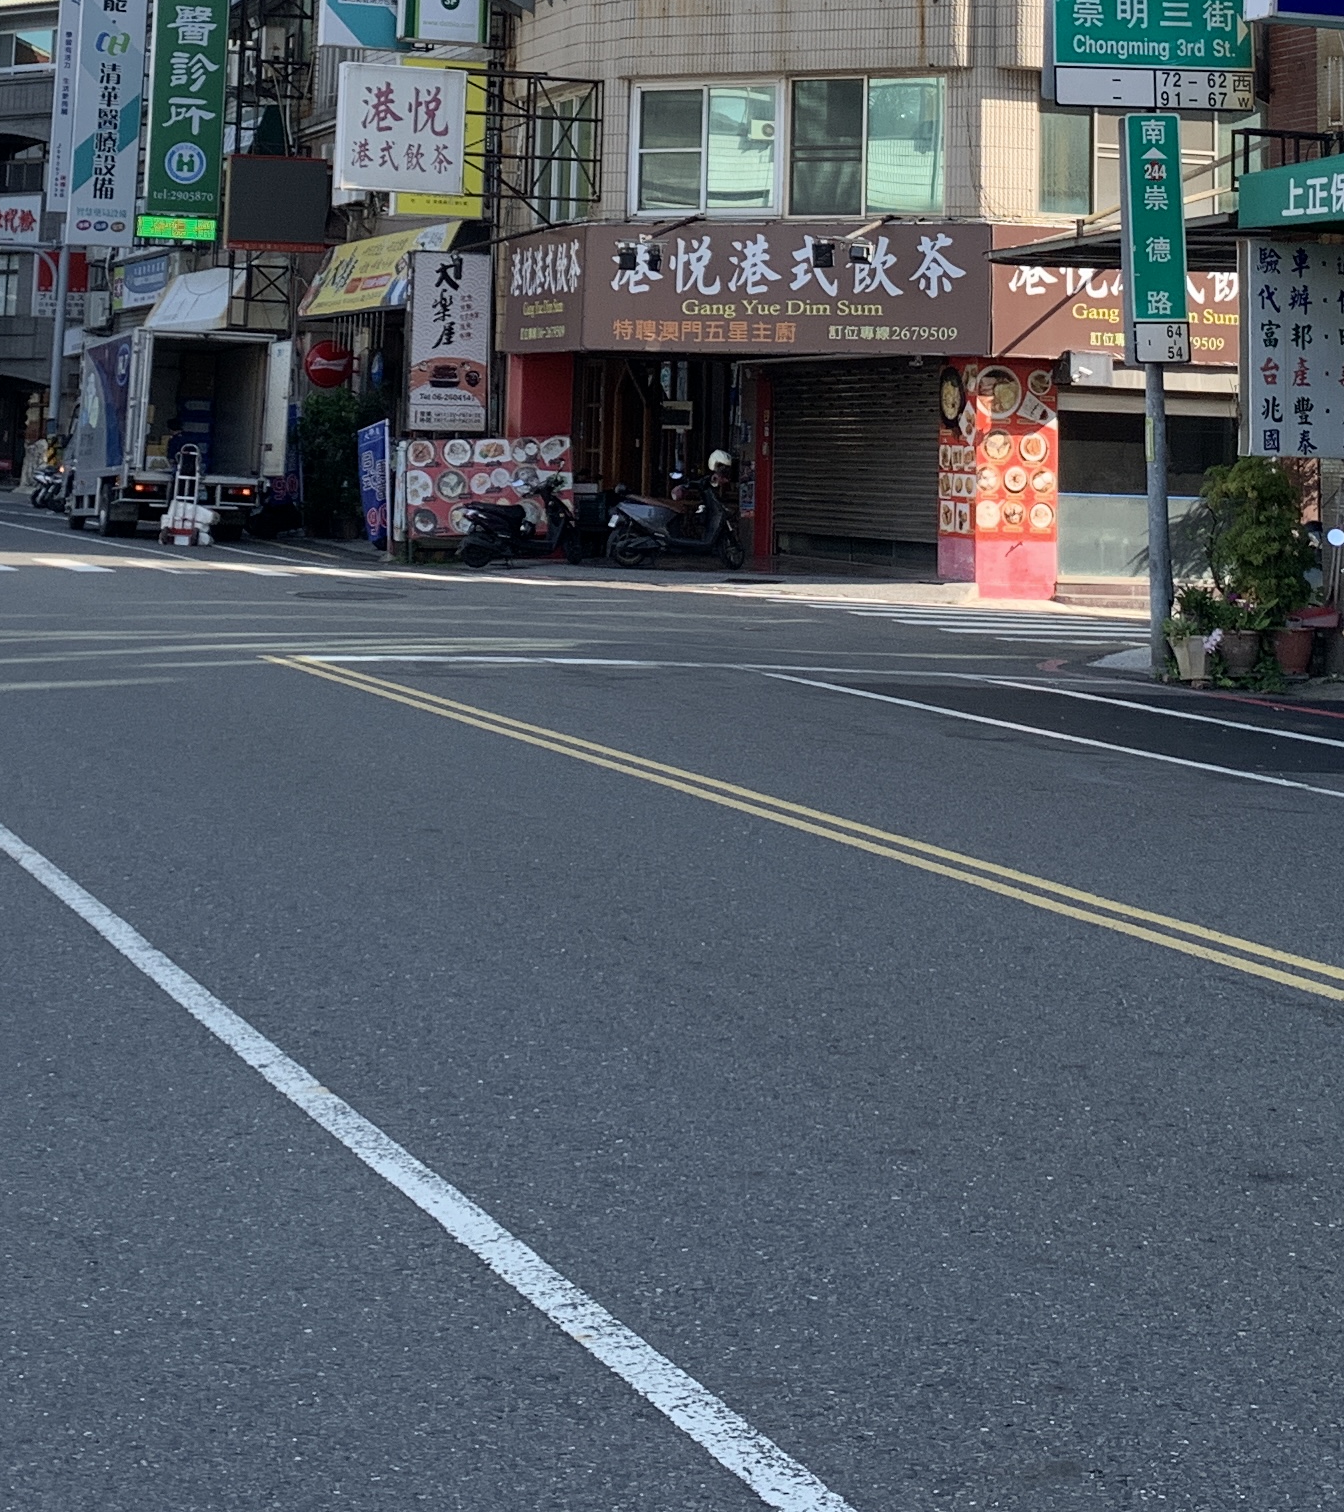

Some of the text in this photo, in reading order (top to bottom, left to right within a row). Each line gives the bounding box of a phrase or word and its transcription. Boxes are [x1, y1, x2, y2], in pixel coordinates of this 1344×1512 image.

[1073, 34, 1236, 60] Chongming 3rd St.
[1232, 74, 1253, 94] 西
[1141, 120, 1166, 145] 南
[351, 140, 454, 175] 港式飲茶
[1143, 184, 1173, 315] 崇德路
[682, 299, 884, 319] Gang Yue Dim Sum
[1072, 303, 1120, 323] Gang
[613, 319, 797, 344] 特聘澳門五星主廚
[1166, 325, 1183, 340] 64
[1167, 346, 1184, 360] 54
